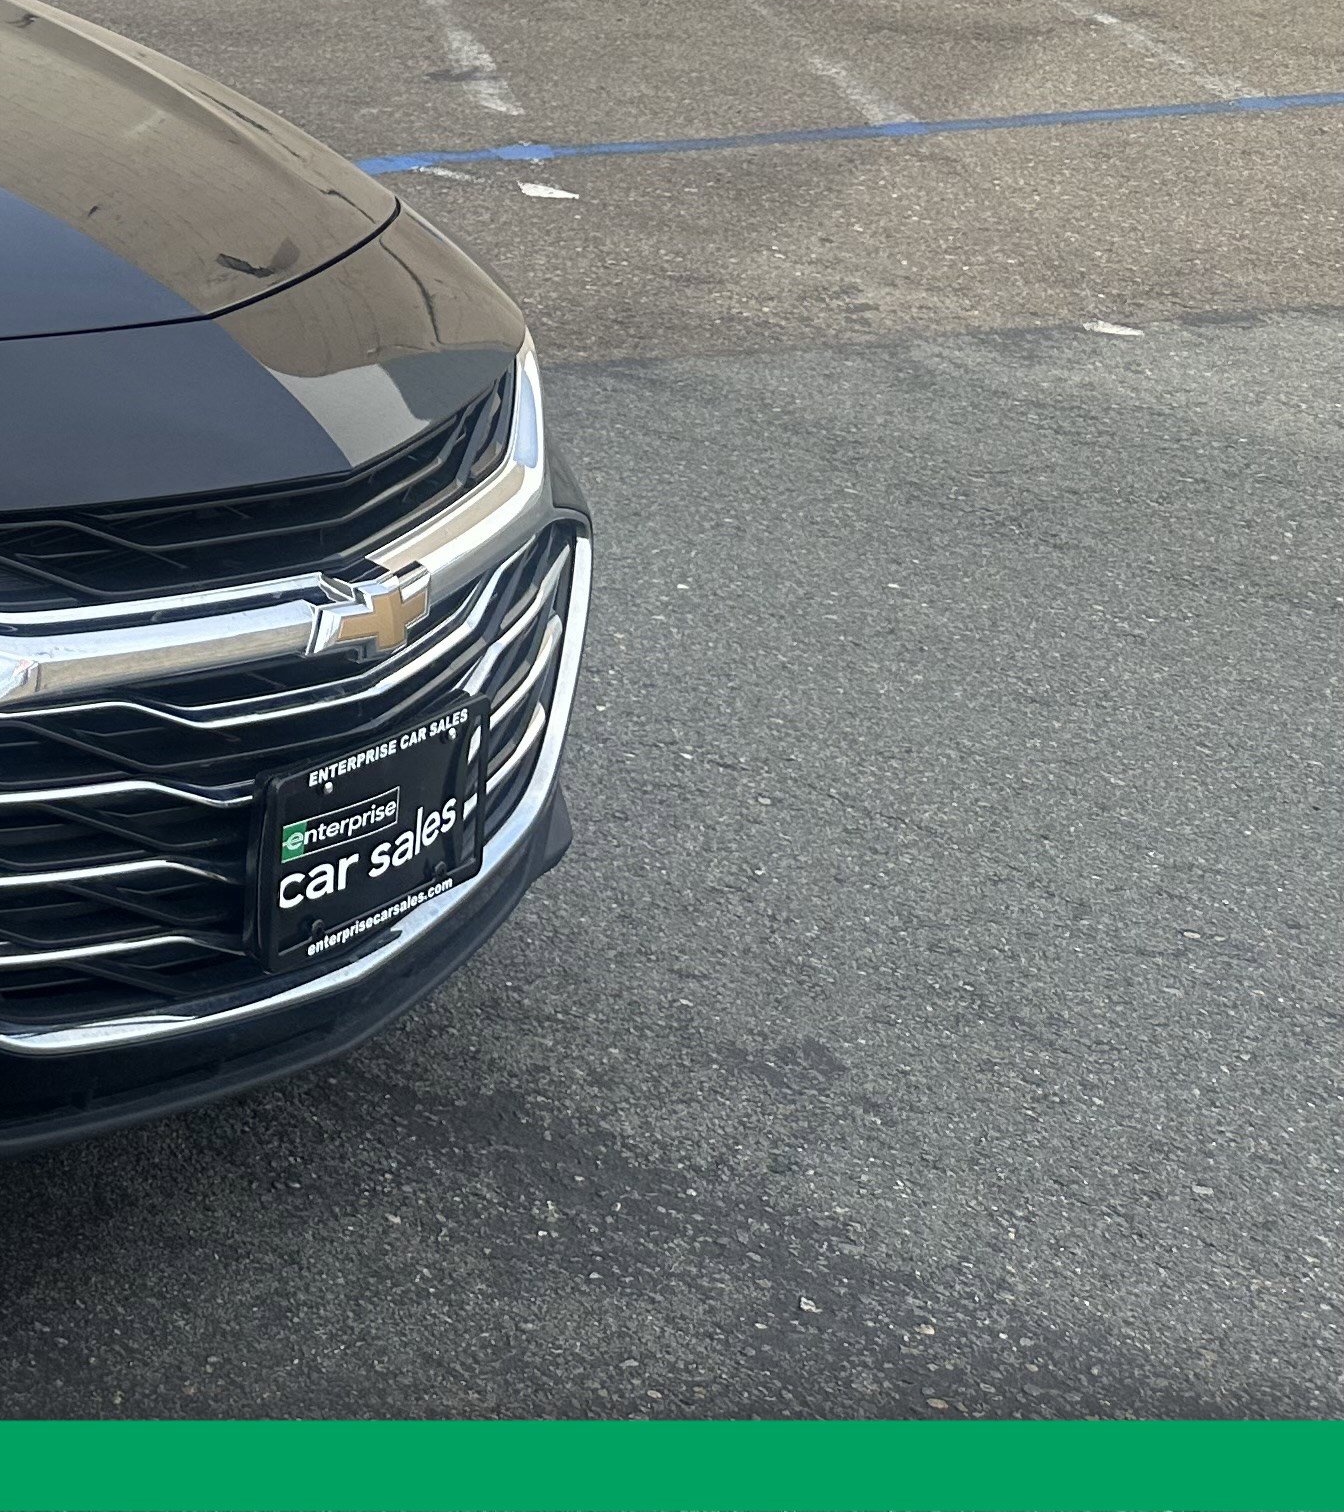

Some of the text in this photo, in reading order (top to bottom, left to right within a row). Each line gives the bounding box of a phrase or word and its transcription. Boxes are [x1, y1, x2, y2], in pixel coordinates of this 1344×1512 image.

[309, 708, 468, 787] ENTERPRISE CAR SALES
[279, 798, 457, 909] car sales
[283, 800, 397, 851] enterprise
[307, 878, 453, 956] enterprisecarsales.com
